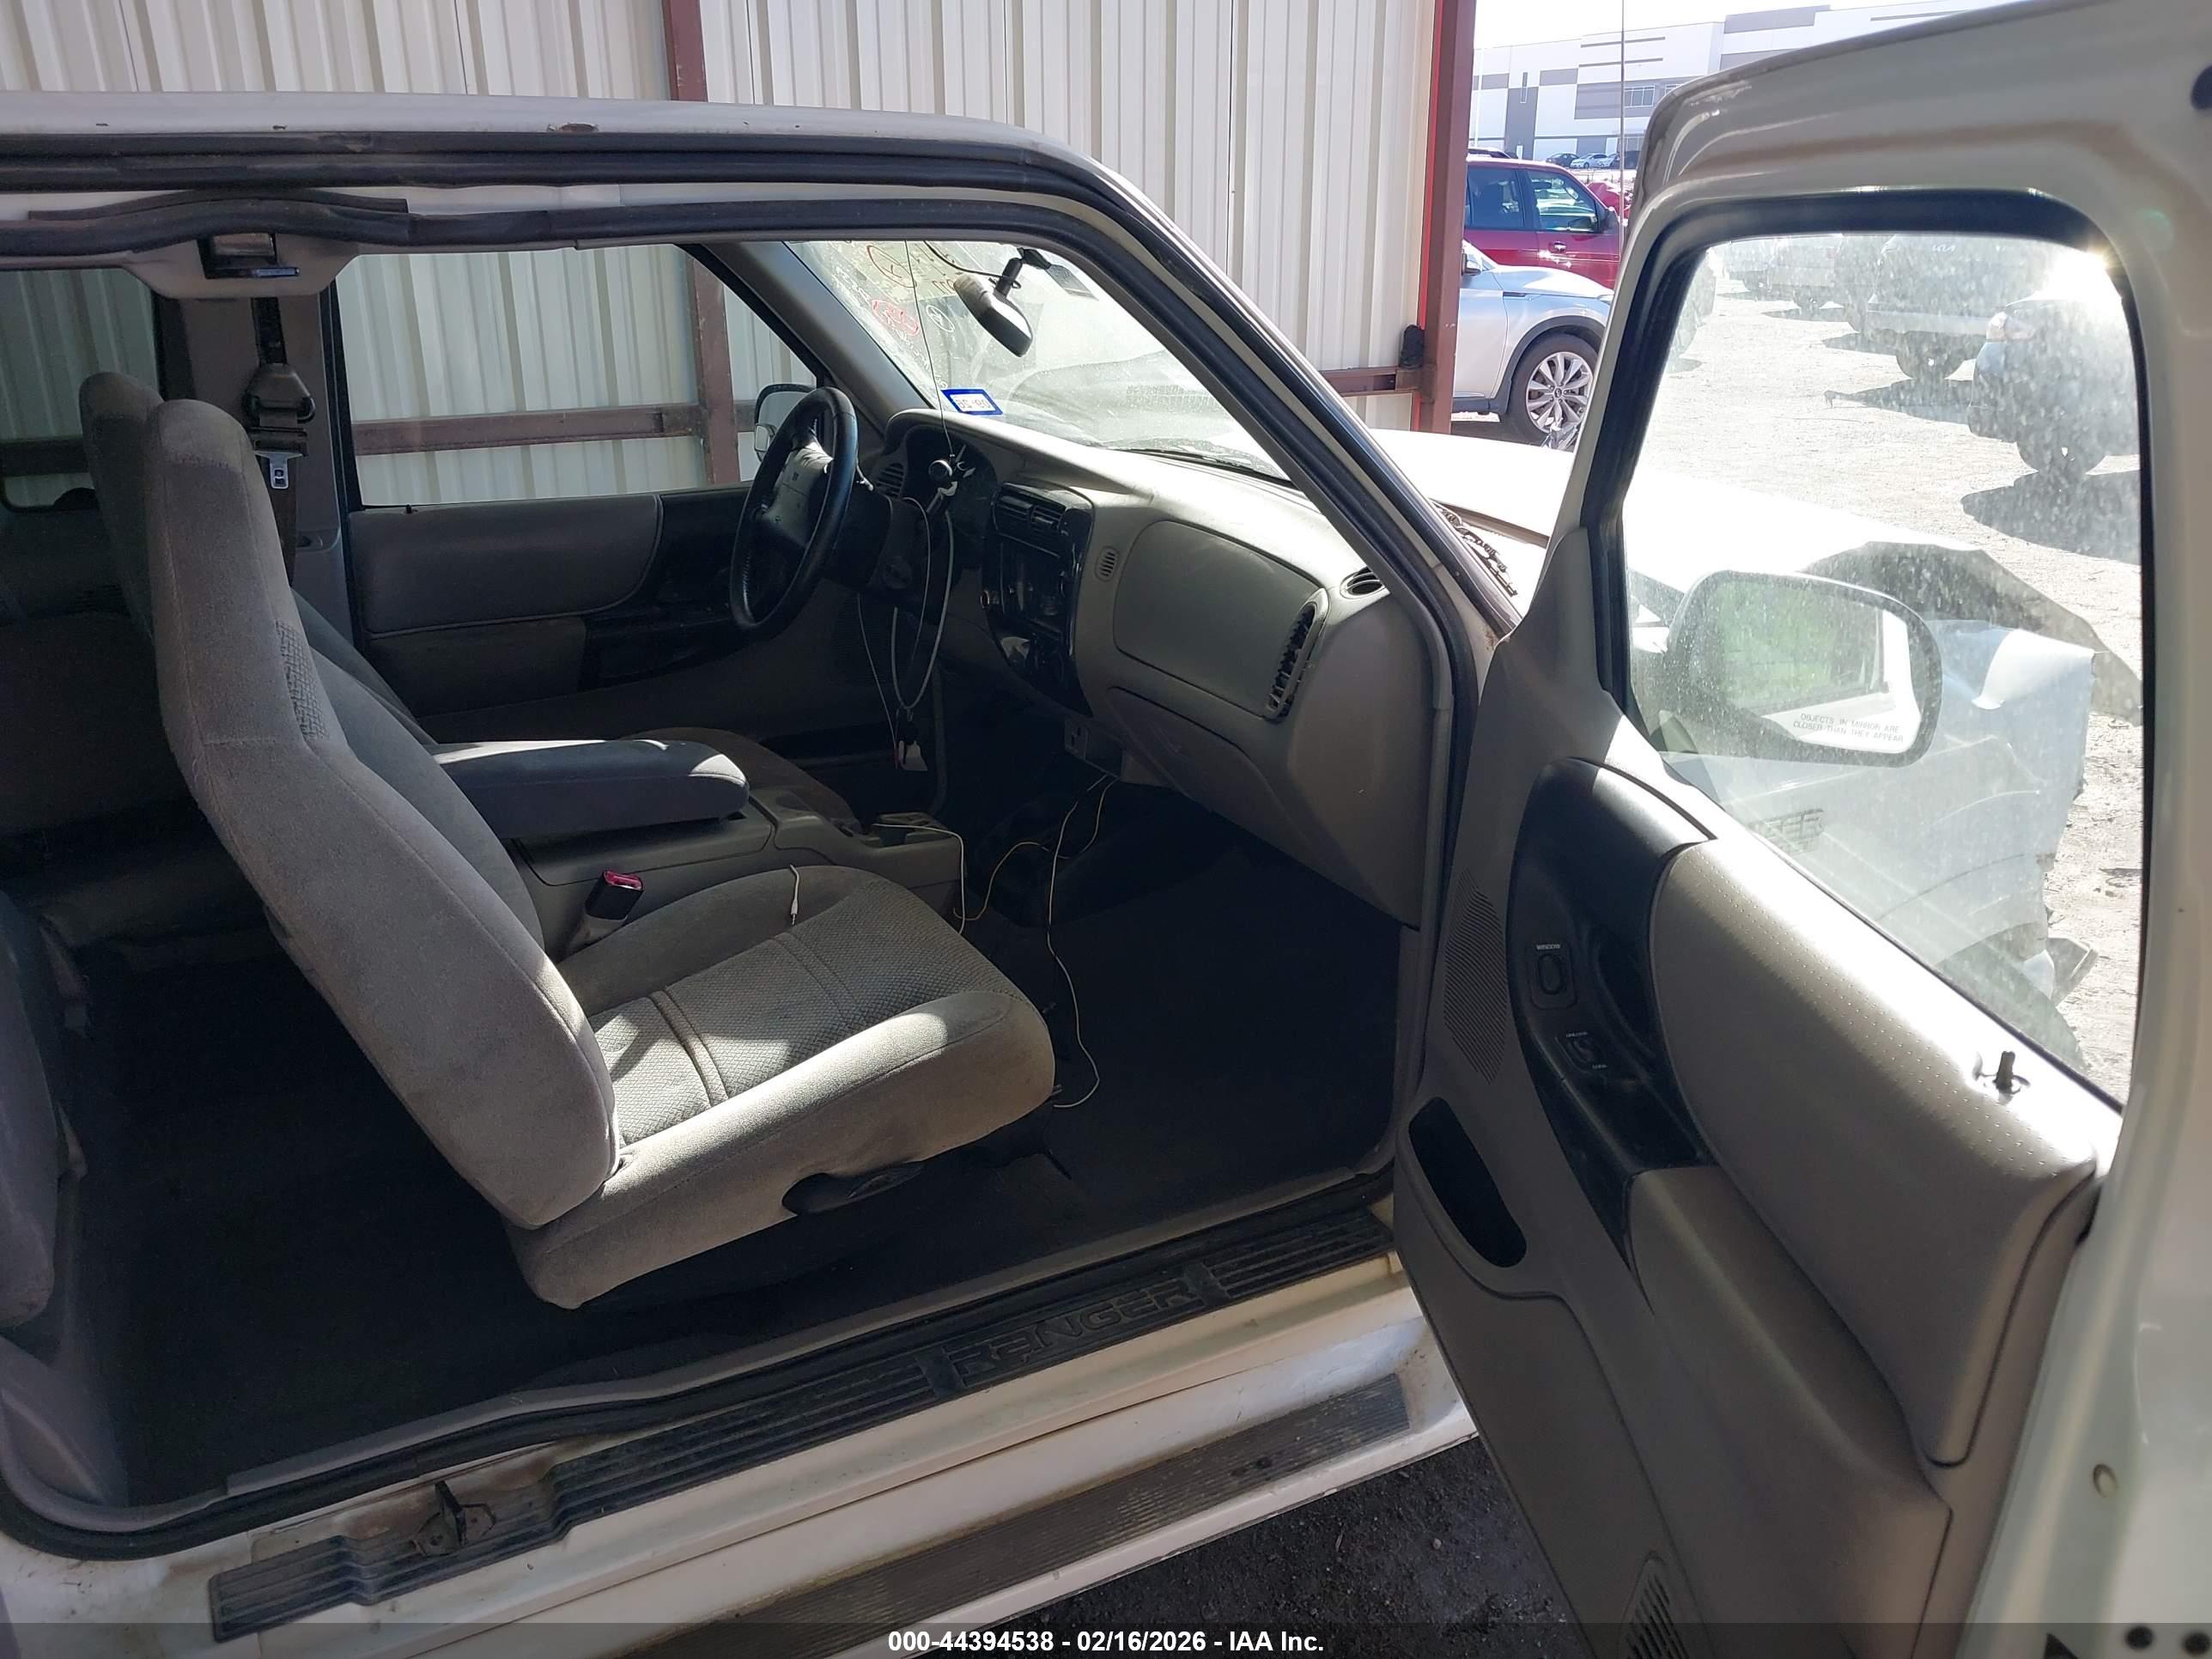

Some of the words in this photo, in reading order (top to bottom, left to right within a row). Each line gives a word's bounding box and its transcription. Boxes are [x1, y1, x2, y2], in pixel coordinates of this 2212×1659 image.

[1793, 720, 1822, 731] CLOSER
[1827, 725, 1847, 735] THAN
[1850, 729, 1869, 738] THEY
[1873, 731, 1904, 742] APPEAR
[1801, 713, 1834, 724] OBJECTS
[1851, 720, 1881, 731] MIRROR
[1885, 725, 1899, 733] ARE
[943, 1277, 1200, 1379] RANGER
